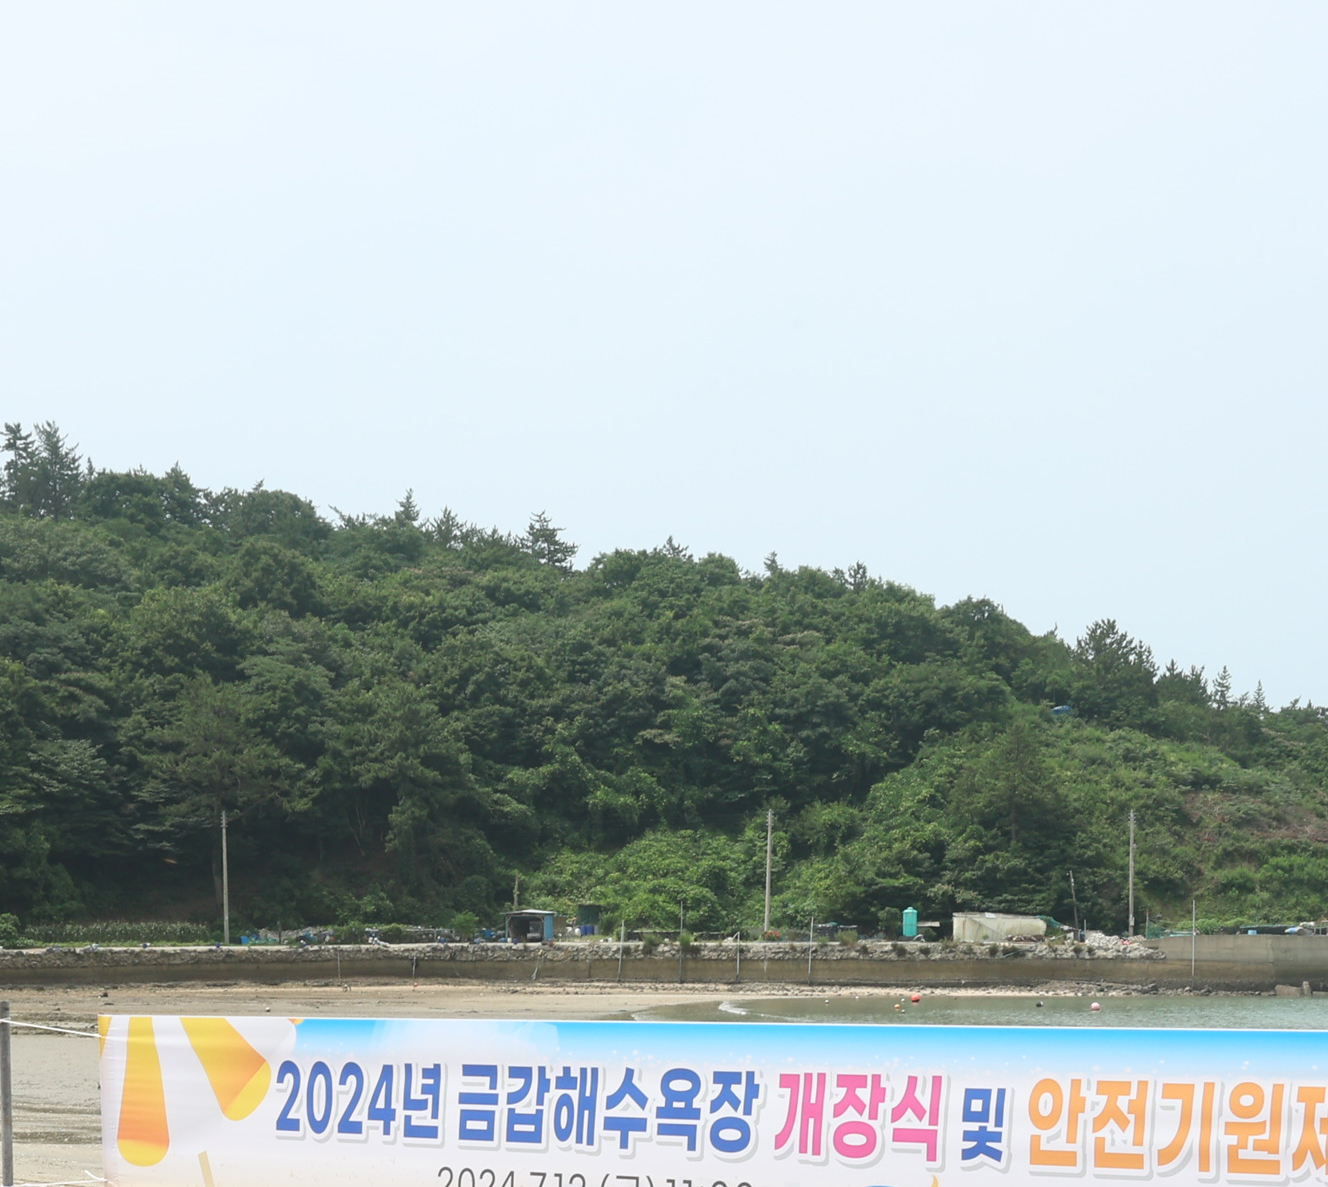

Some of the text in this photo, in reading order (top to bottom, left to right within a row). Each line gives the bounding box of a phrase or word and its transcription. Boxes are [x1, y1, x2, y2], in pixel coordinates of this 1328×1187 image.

[275, 1060, 441, 1139] 2024년
[458, 1065, 760, 1153] 금갑해수욕장
[774, 1073, 941, 1161] 개장식
[961, 1087, 1005, 1162] 및
